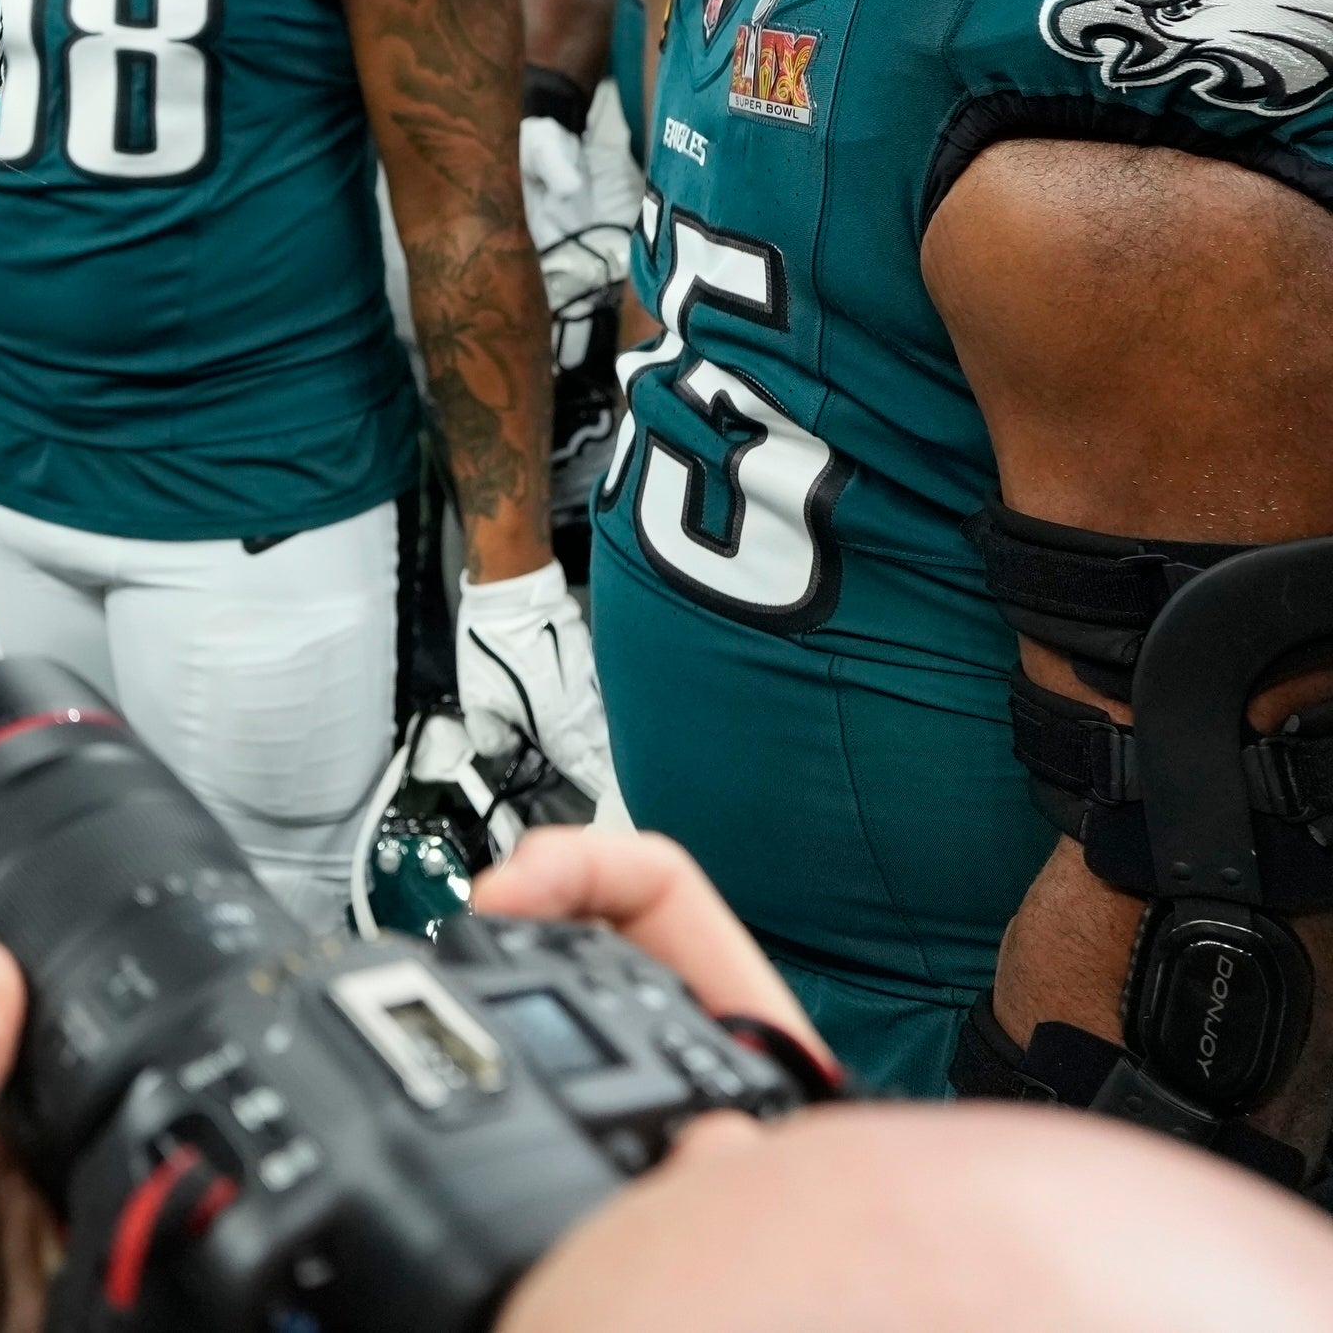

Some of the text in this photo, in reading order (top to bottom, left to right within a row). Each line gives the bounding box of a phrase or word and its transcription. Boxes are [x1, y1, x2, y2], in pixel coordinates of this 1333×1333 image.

[731, 23, 817, 107] LIX
[734, 95, 800, 120] SUPER BOWL
[662, 117, 709, 167] EAGLES
[1196, 954, 1234, 1079] DONJOY
